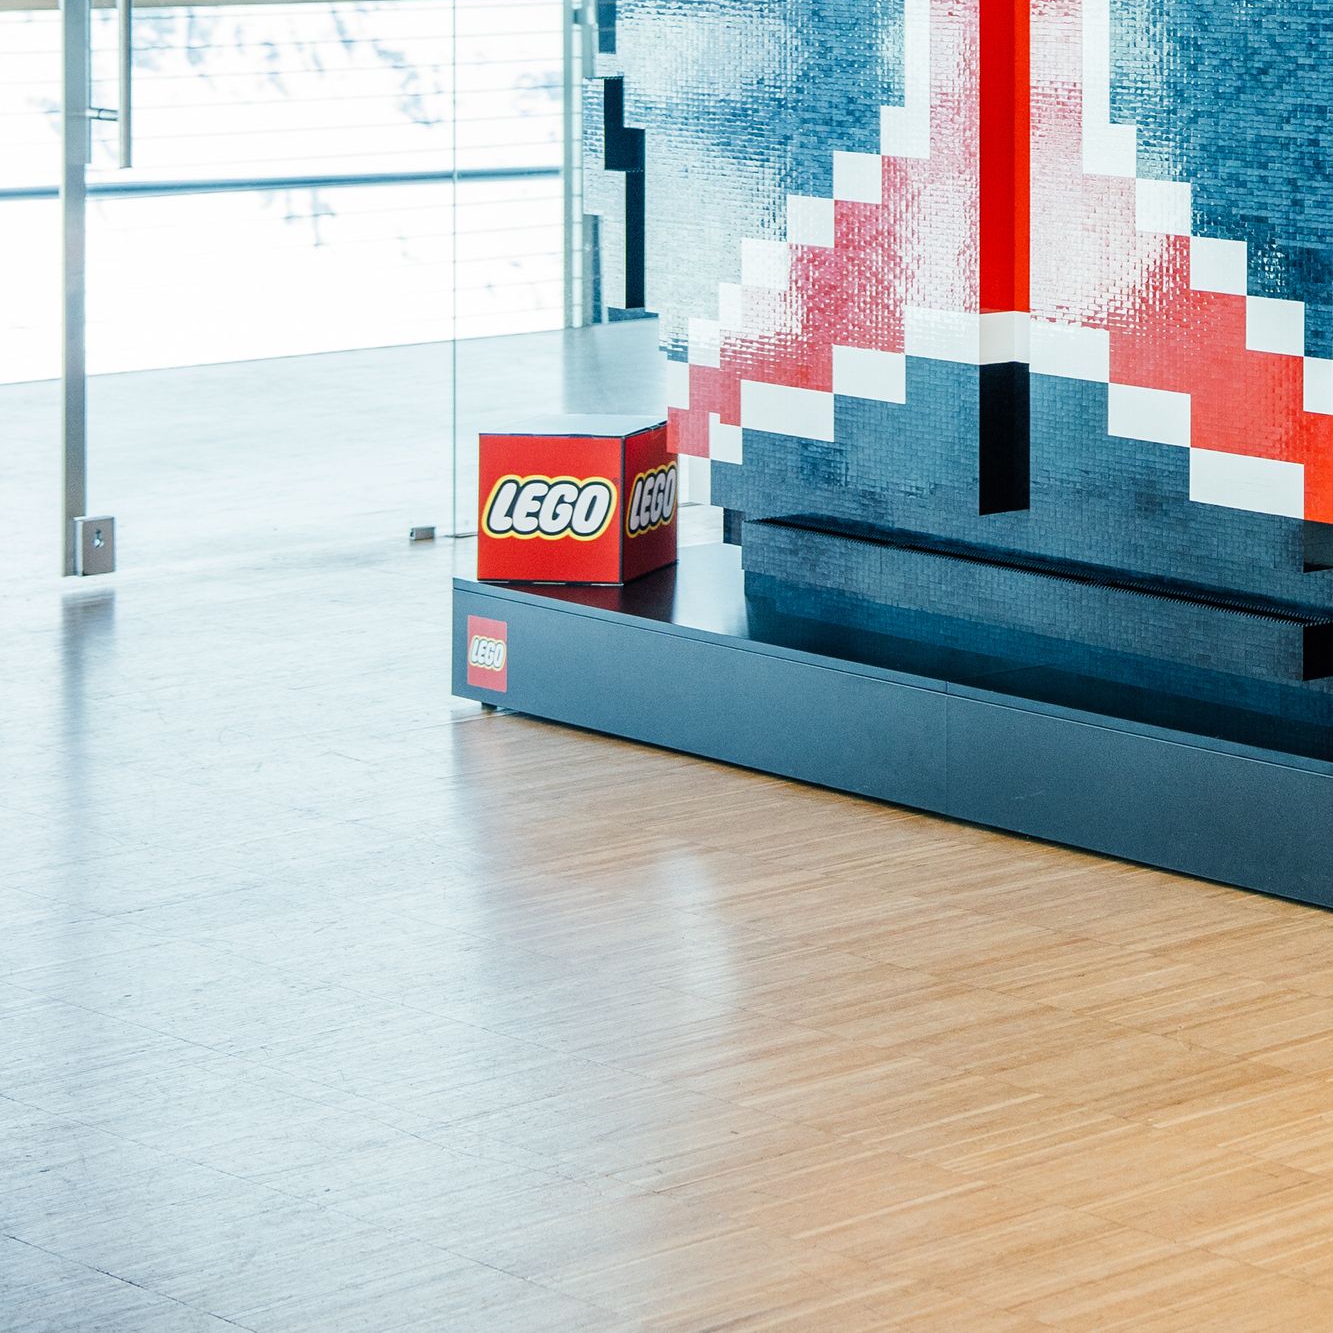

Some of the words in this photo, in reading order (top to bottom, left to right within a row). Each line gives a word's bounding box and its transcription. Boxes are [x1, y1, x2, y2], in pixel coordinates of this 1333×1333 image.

[485, 478, 613, 537] LEGO
[628, 465, 677, 533] LEGO
[470, 637, 505, 669] LEGO
